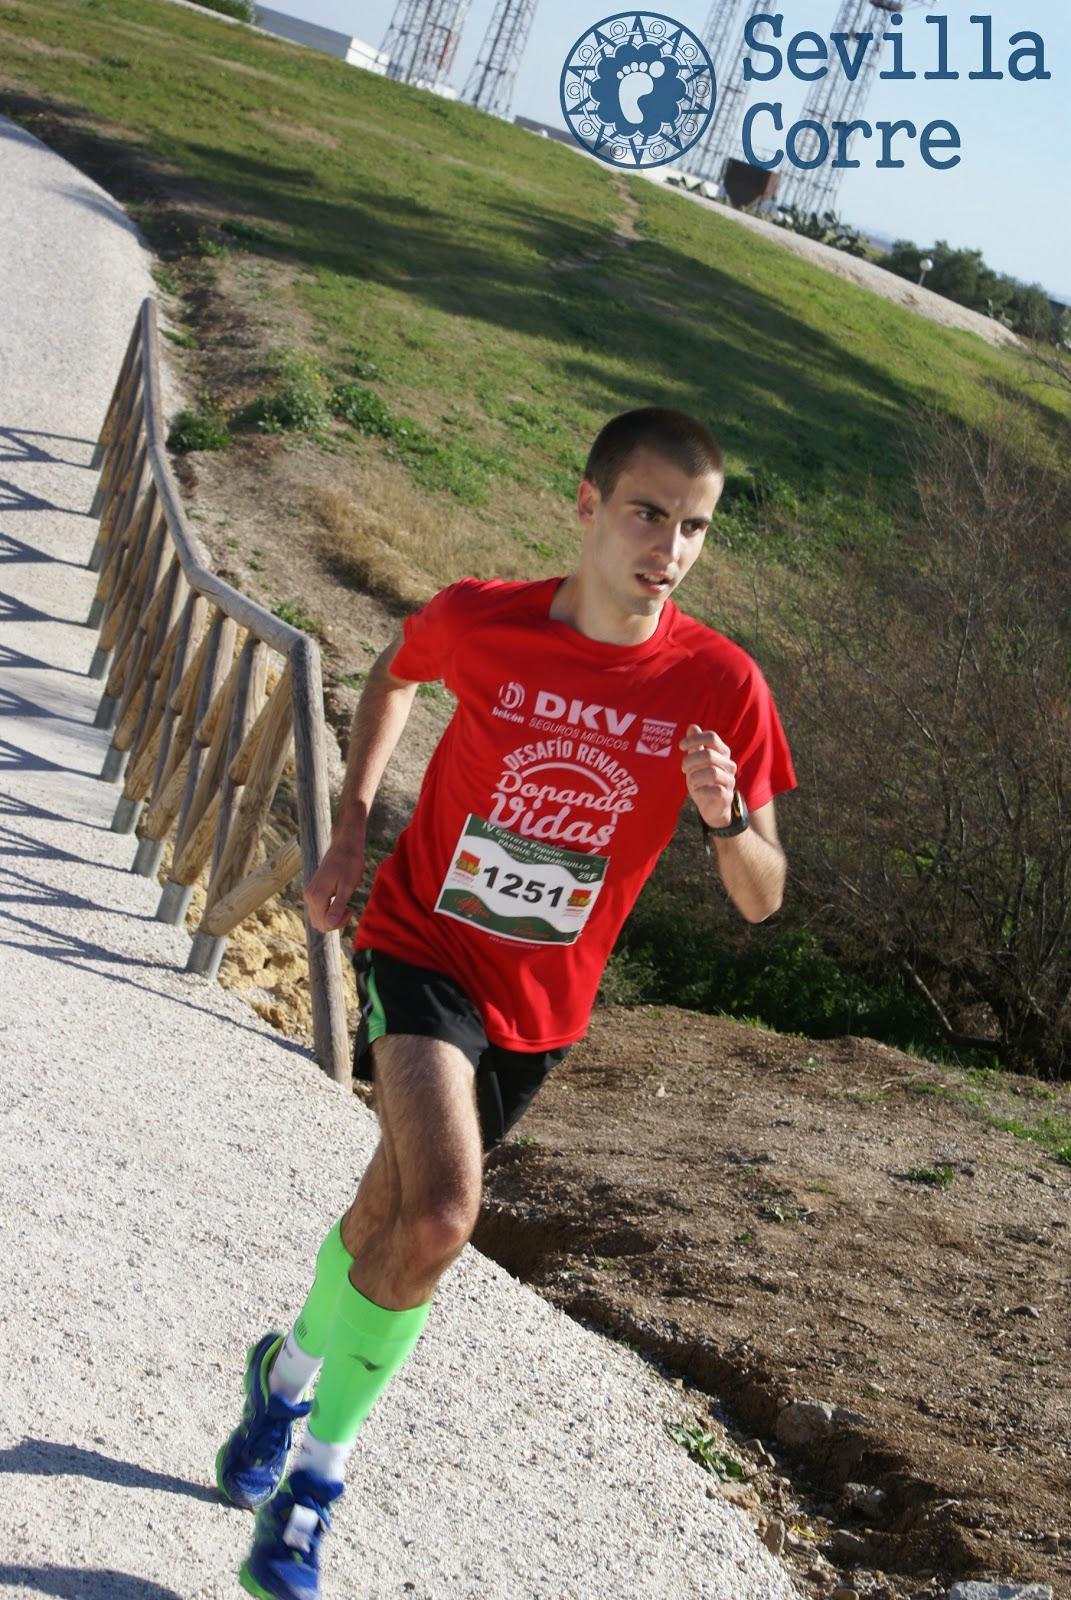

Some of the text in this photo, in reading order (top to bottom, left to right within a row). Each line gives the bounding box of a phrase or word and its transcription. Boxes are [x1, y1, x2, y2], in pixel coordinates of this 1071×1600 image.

[529, 717, 630, 751] SEGUROS MÉDICOS
[533, 690, 637, 737] DKV
[642, 724, 674, 736] BOSCH
[503, 736, 639, 798] DESAFÍO RENACER
[496, 770, 635, 813] Donando
[488, 792, 616, 847] Vidas
[498, 839, 531, 856] PARQUE
[530, 843, 564, 857] Popular
[483, 865, 565, 908] 1251
